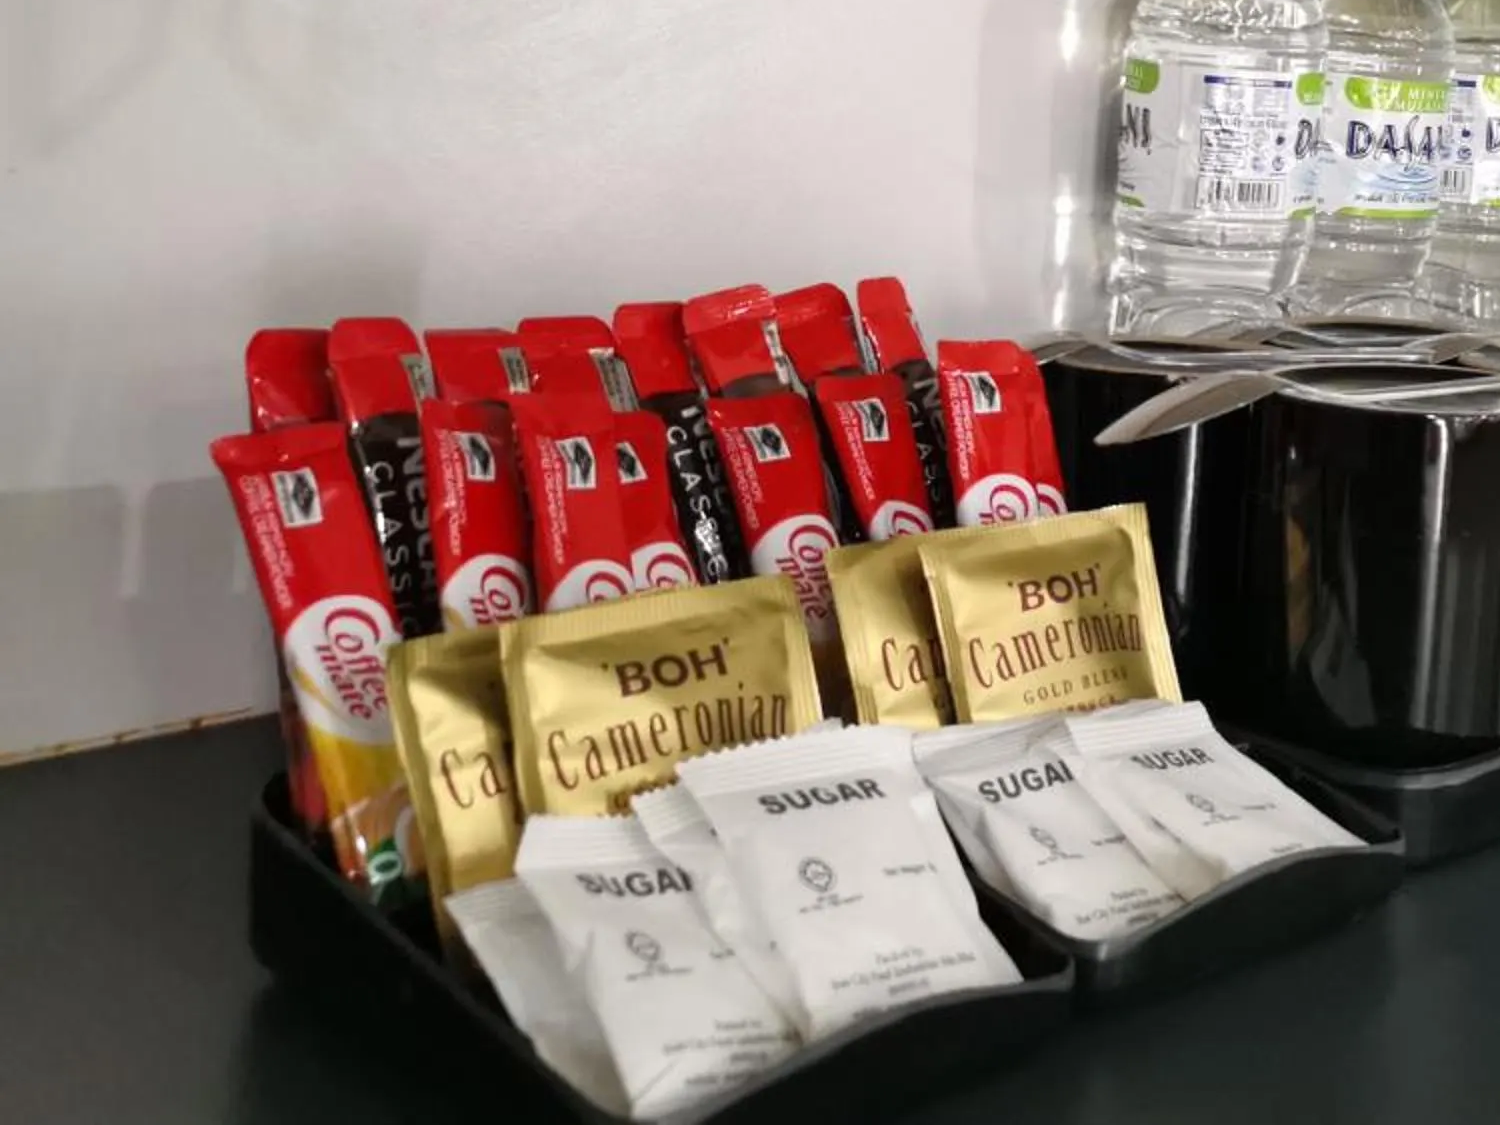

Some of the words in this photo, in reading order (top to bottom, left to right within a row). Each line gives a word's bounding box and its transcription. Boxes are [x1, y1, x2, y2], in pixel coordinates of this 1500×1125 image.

[969, 602, 1142, 689] Cameronian
[1022, 680, 1074, 705] GOLD
[546, 683, 789, 794] Cameronian
[758, 778, 887, 815] SUGAR
